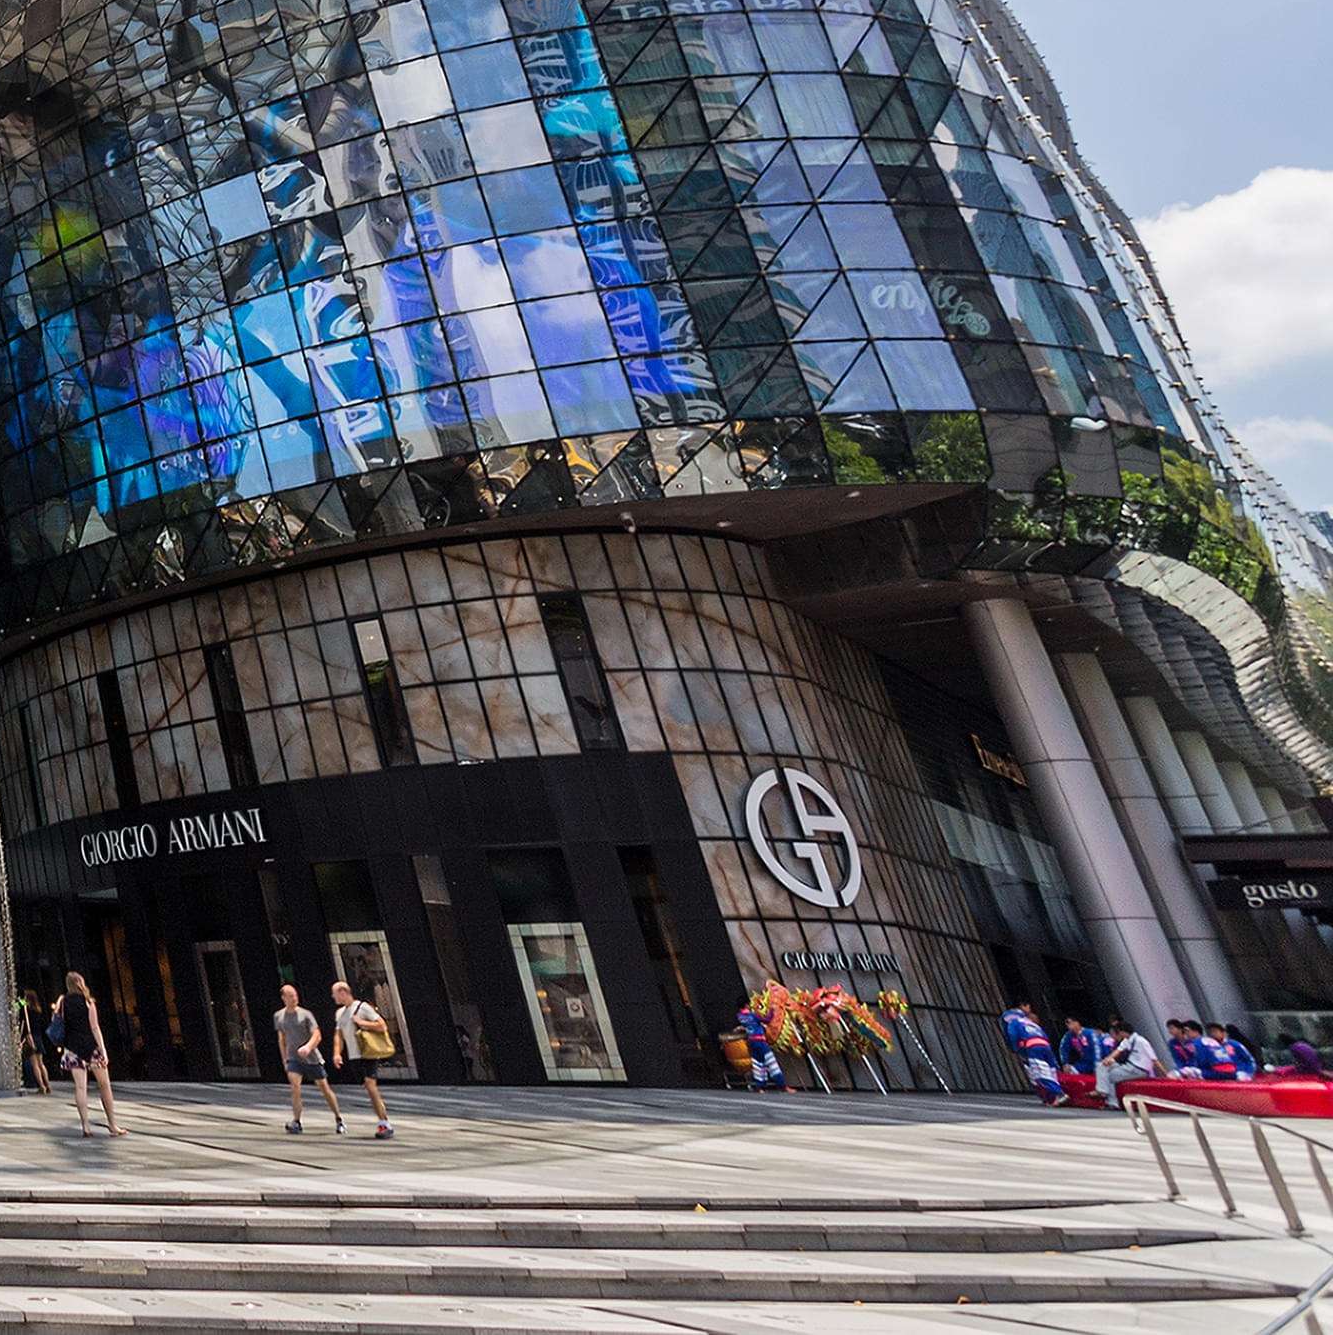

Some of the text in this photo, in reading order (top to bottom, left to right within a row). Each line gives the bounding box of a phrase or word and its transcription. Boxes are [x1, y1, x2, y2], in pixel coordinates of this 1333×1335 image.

[80, 808, 267, 867] GIORGIO ARMANI
[1242, 879, 1318, 908] gusto
[783, 951, 852, 972] GIORGIO
